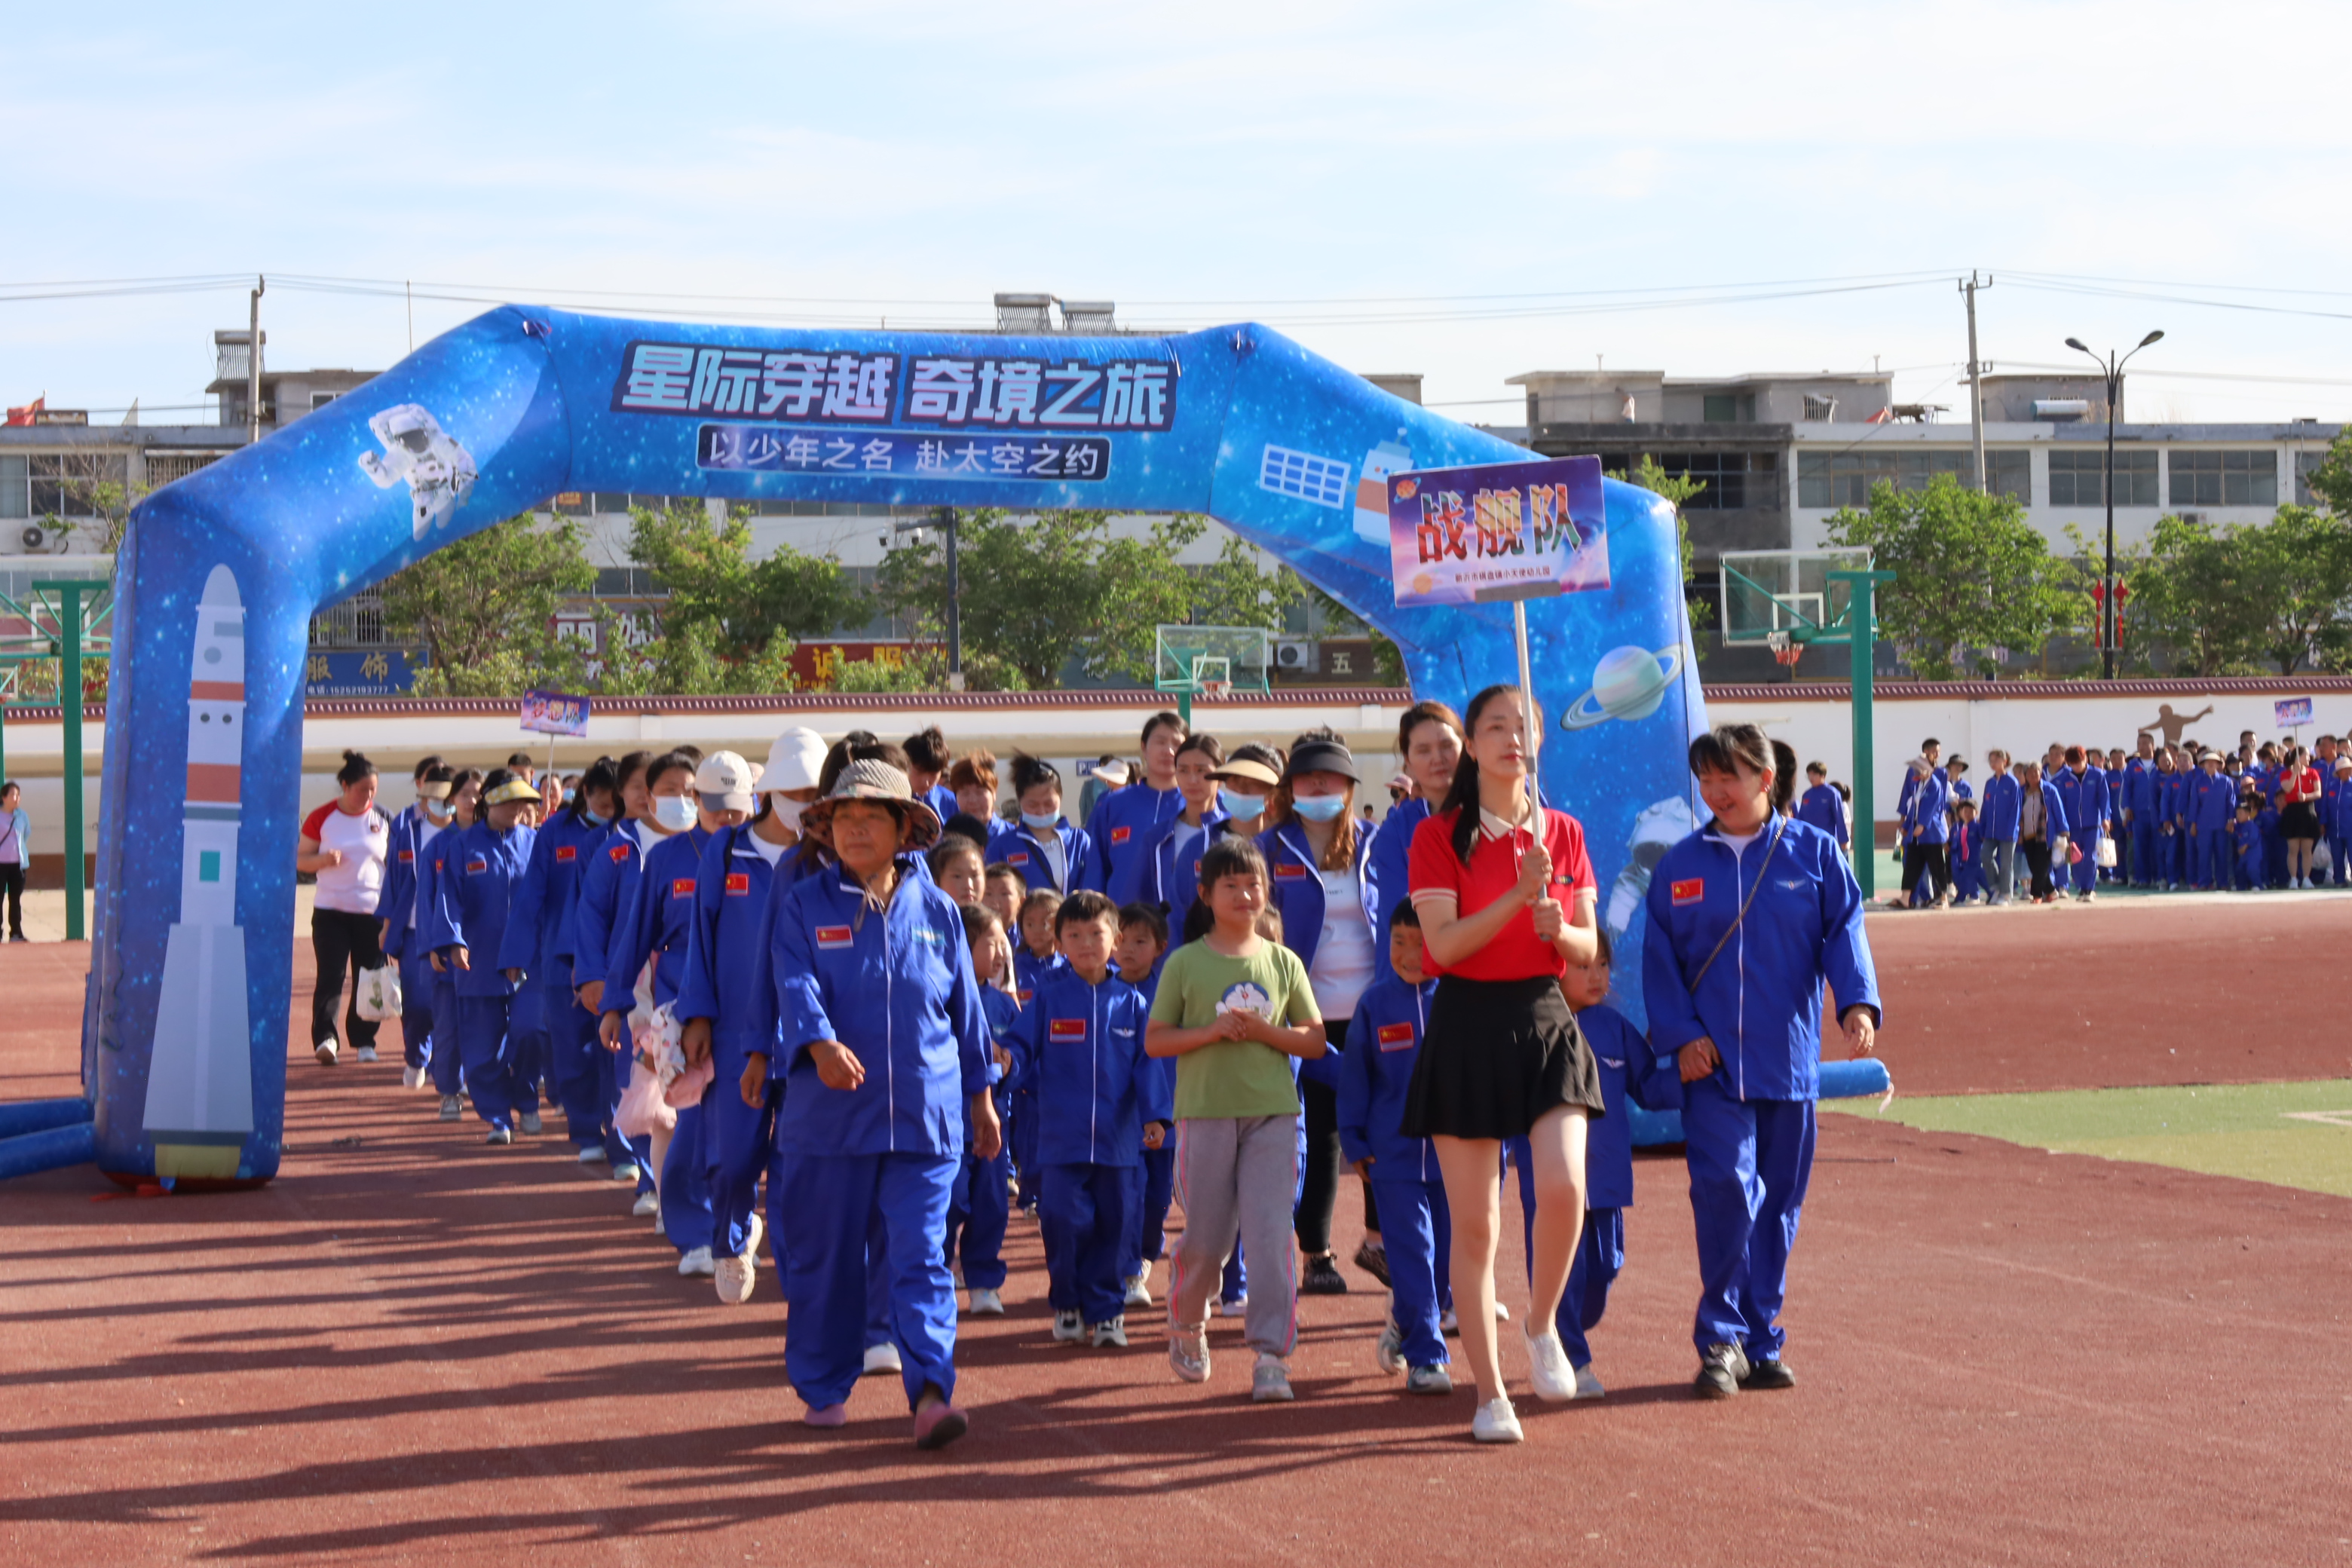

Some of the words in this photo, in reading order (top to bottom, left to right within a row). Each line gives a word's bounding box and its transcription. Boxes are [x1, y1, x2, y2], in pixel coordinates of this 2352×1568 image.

[621, 344, 894, 419] 星际穿越
[909, 358, 1171, 427] 奇境之旅
[709, 431, 893, 472] 以少年之名
[914, 440, 1098, 476] 赴太空之约
[1415, 482, 1582, 565] 战舰队
